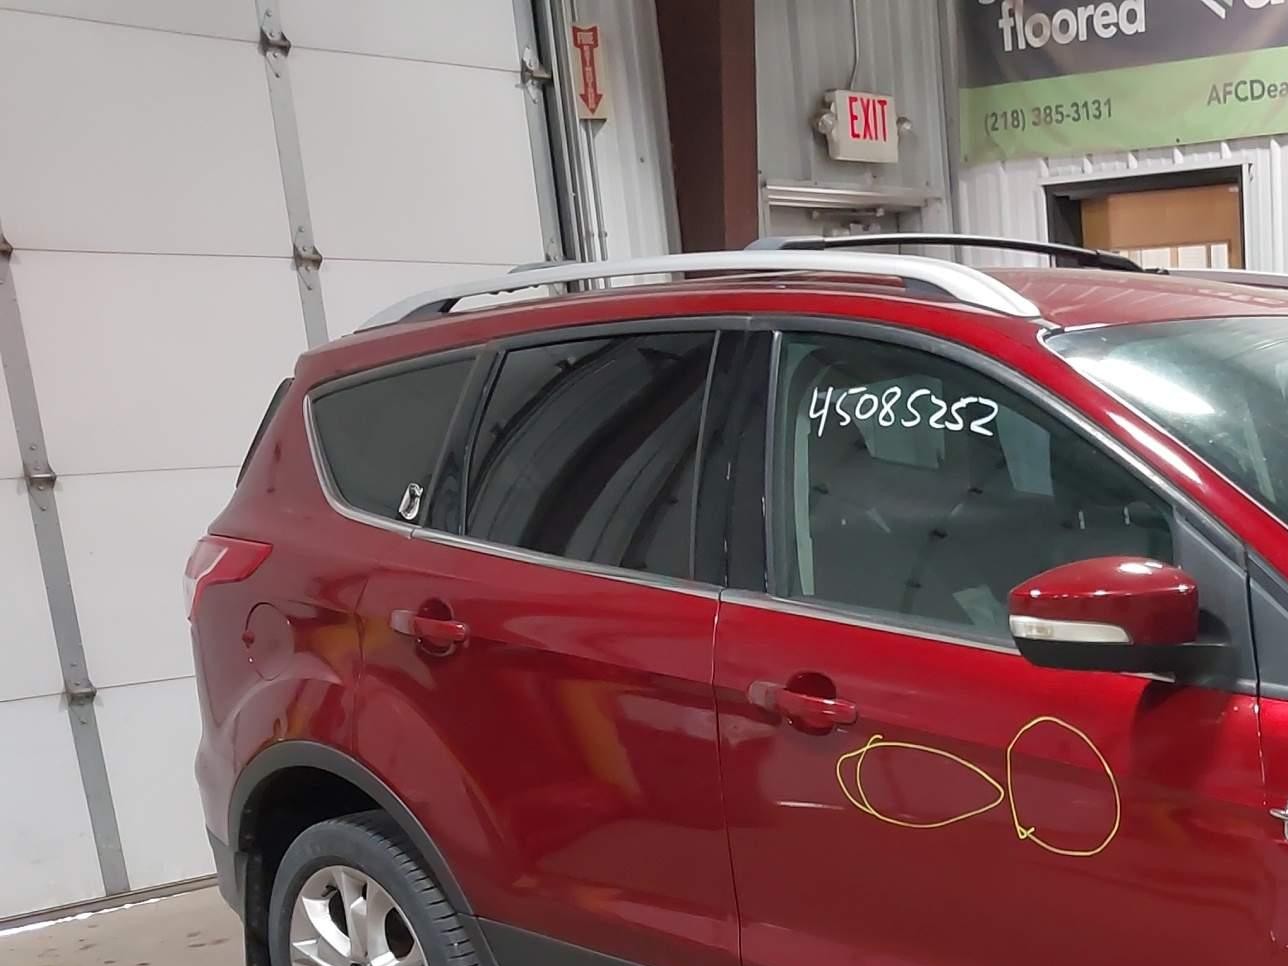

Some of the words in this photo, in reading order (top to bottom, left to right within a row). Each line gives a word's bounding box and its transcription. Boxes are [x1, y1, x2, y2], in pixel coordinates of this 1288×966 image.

[998, 0, 1146, 51] floored
[848, 96, 888, 142] EXIT
[984, 108, 1026, 136] (218)
[1031, 98, 1113, 127] 385-3131
[808, 386, 999, 437] 45085252
